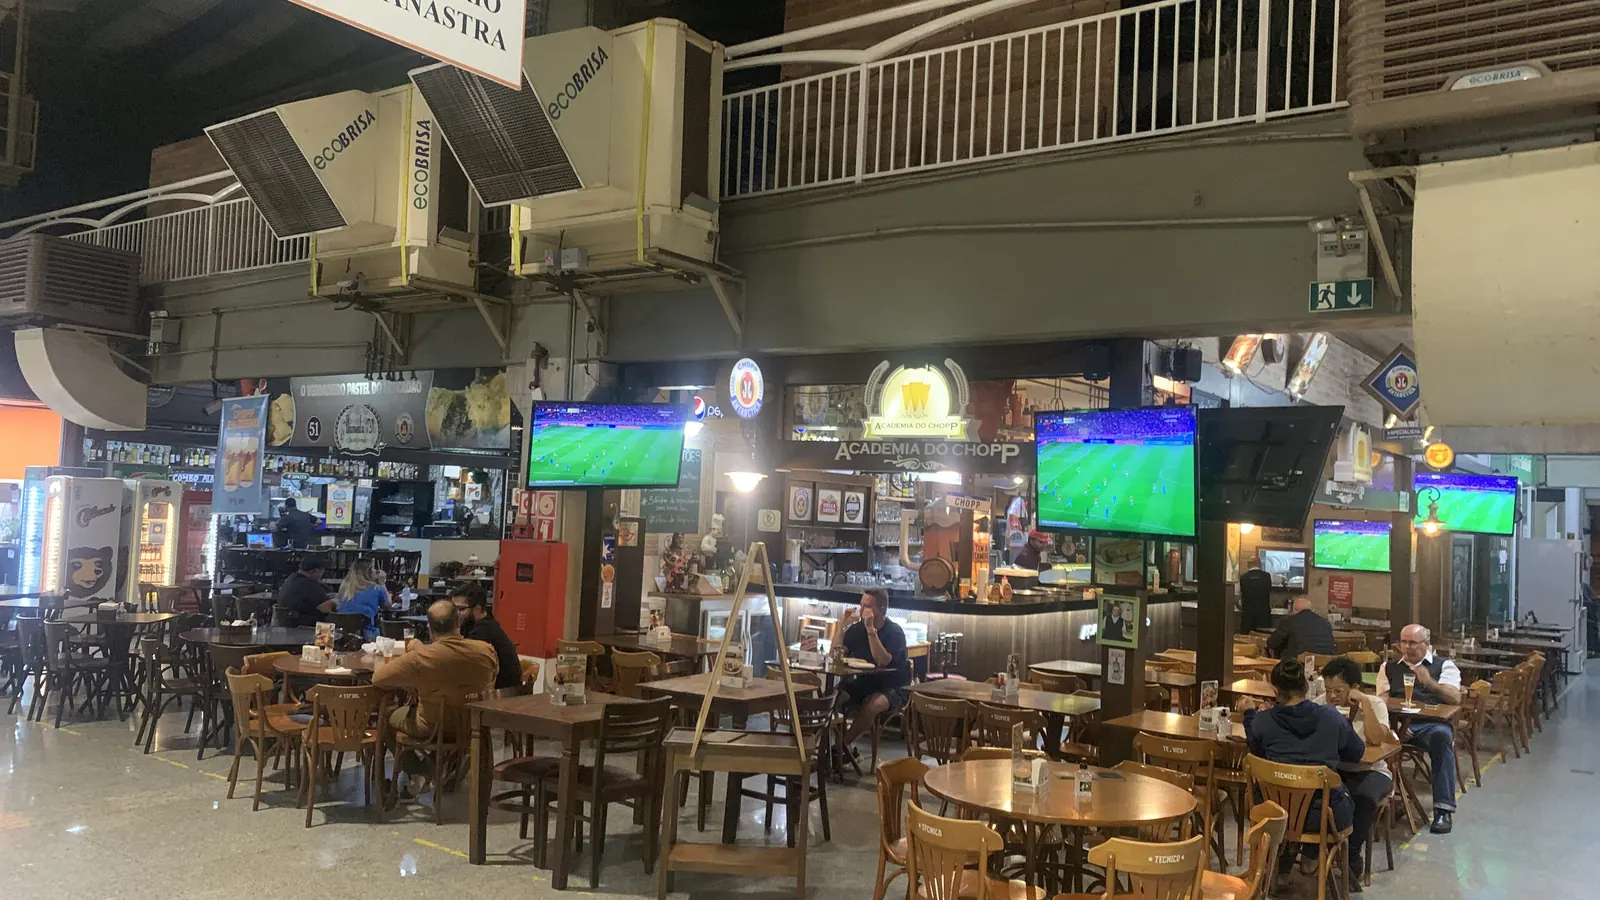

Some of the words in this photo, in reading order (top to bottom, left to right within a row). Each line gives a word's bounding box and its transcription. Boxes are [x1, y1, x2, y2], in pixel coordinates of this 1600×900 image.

[547, 45, 609, 121] ecoBRISA
[1469, 70, 1521, 85] ecoBRISA
[313, 109, 376, 170] ecoBRISA
[413, 119, 431, 210] ecoBRISA
[346, 381, 370, 396] PASTEL
[308, 421, 319, 437] 51
[874, 422, 914, 431] ACADEMIA
[928, 422, 958, 431] CHOPP
[834, 442, 920, 461] ACADEMIA
[924, 443, 948, 456] DO
[951, 442, 1020, 464] CHOPP
[172, 474, 199, 483] COMBO
[954, 497, 981, 510] CHOPP
[1274, 771, 1297, 781] TECNICO
[1154, 854, 1181, 864] TECNICO
